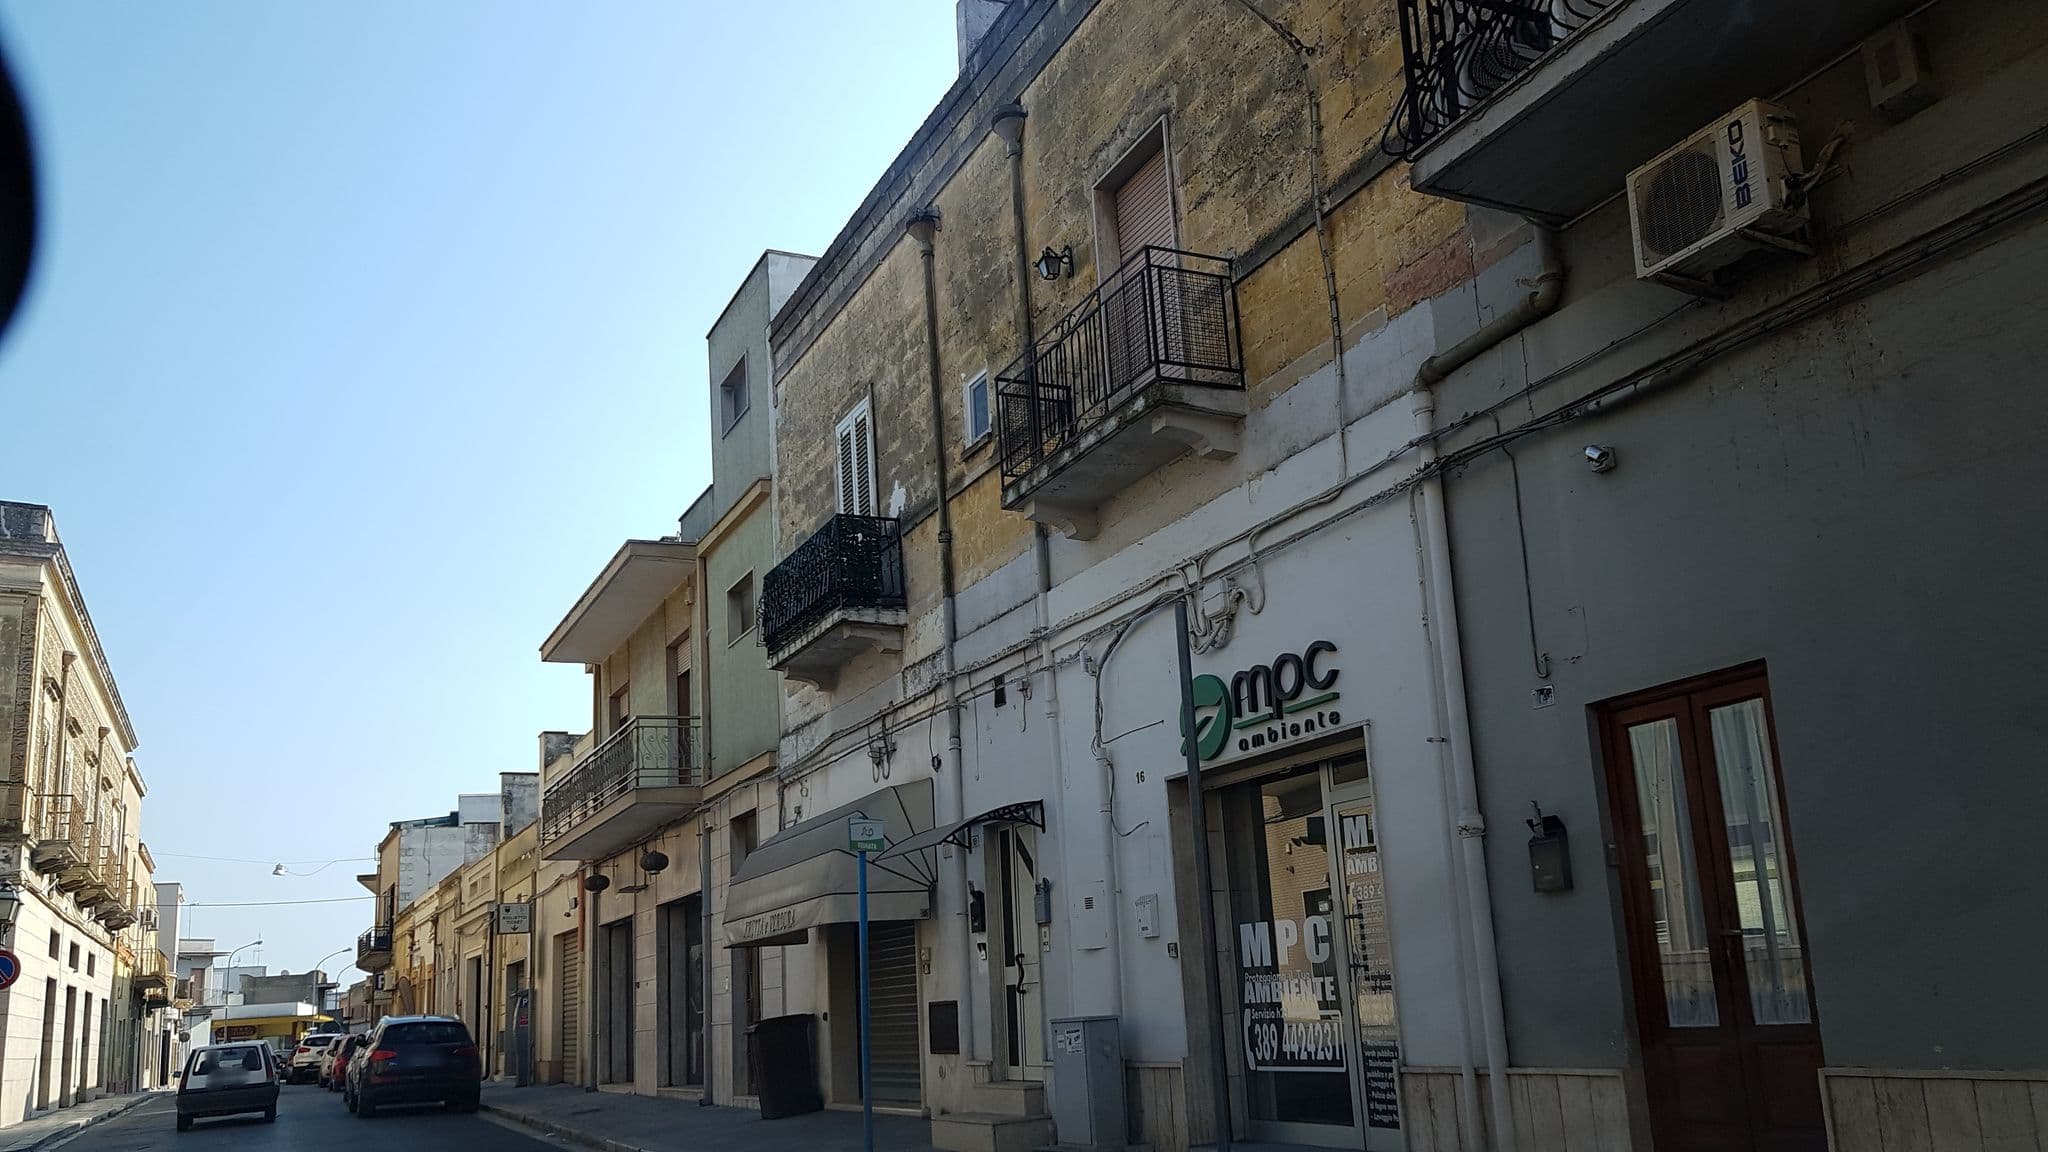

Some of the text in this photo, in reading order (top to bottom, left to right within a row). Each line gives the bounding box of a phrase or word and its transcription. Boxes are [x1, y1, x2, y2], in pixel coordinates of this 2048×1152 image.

[1727, 119, 1752, 210] BEKO
[1230, 640, 1341, 720] mpc
[1238, 710, 1342, 752] ambiente
[1135, 770, 1146, 785] 16
[1357, 884, 1375, 900] 389
[1244, 976, 1337, 1004] AMBIENTE
[1251, 1007, 1276, 1020] Servizio
[1254, 1022, 1341, 1061] 389 4424231
